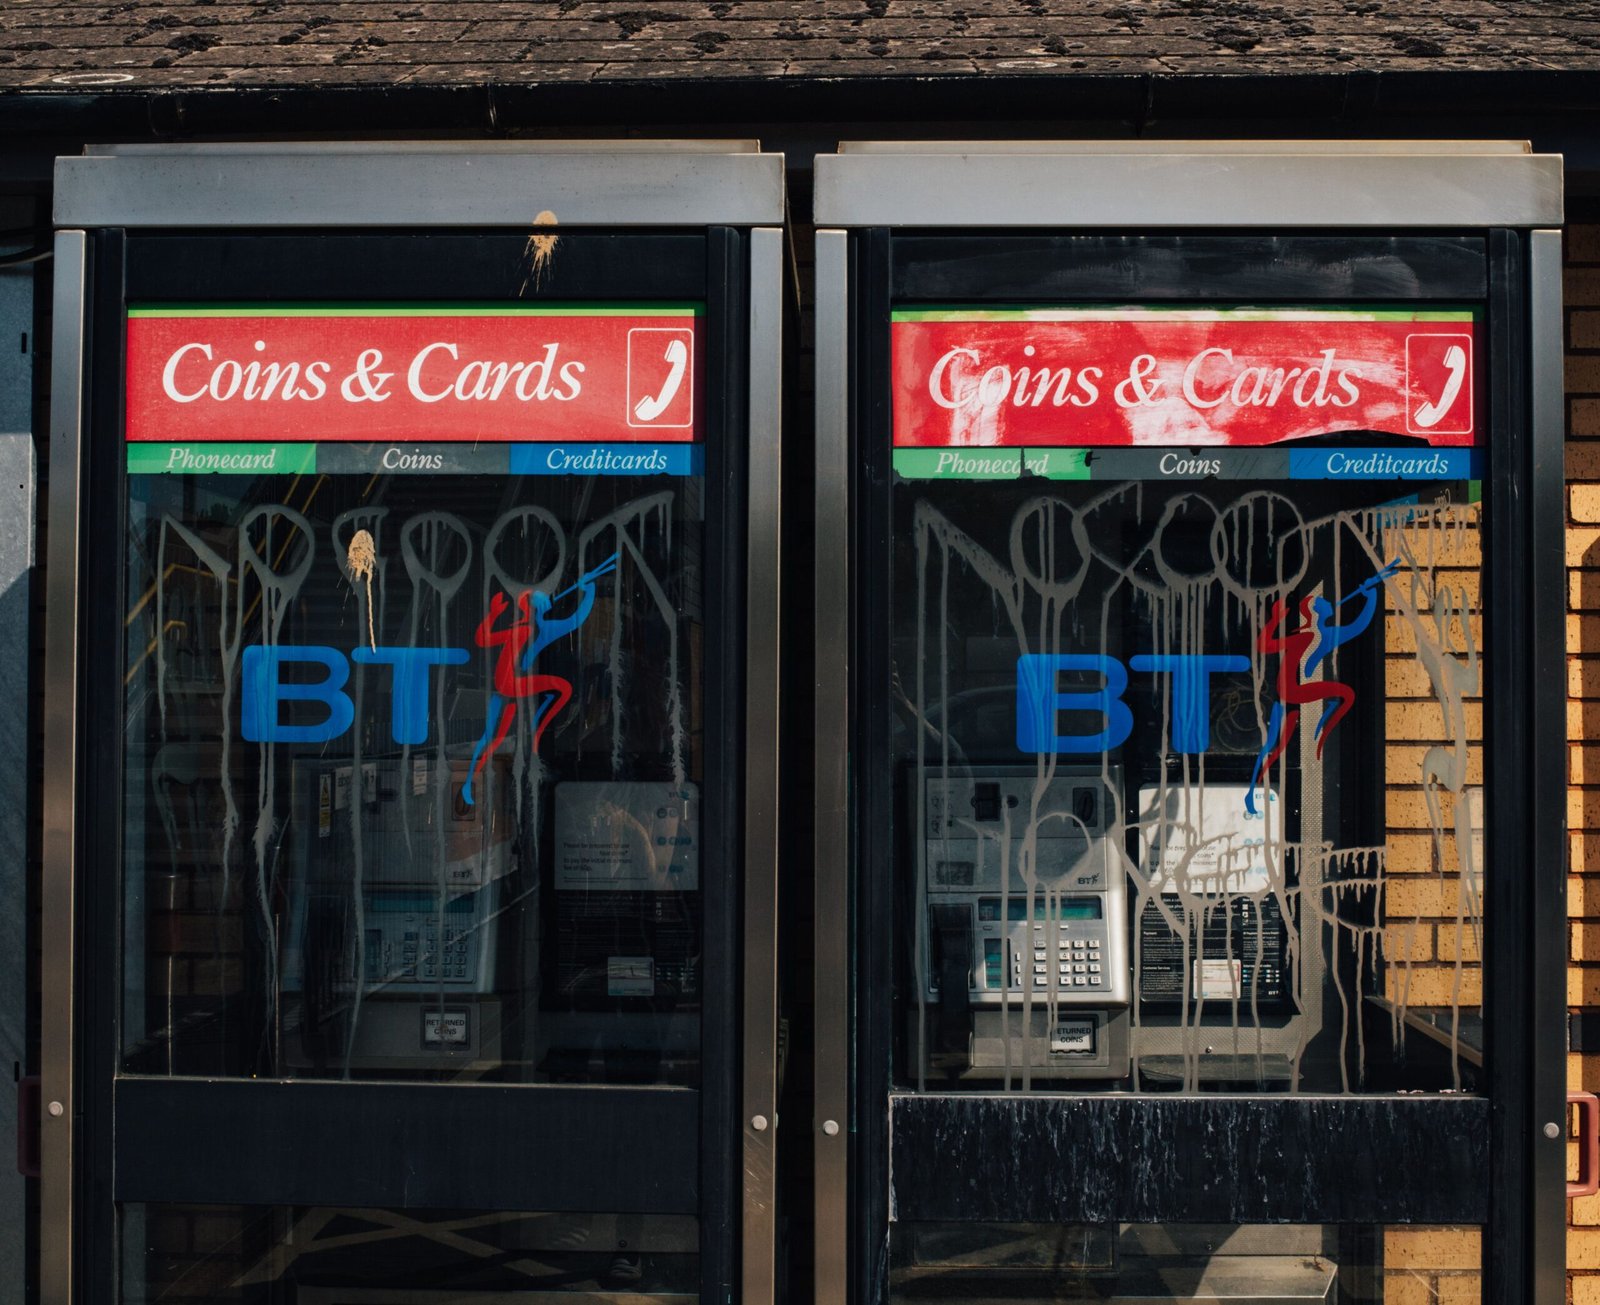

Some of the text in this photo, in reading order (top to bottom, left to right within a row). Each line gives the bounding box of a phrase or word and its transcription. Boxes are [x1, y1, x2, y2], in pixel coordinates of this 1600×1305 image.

[162, 340, 586, 403] Coins & Cards
[928, 345, 1363, 410] Coins & Cards
[166, 448, 276, 470] Phonecard
[382, 448, 443, 470] Coins
[546, 449, 668, 471] Creditcards
[1159, 453, 1221, 475] Coins
[1326, 453, 1449, 475] Creditcards
[241, 644, 470, 745] BT
[1016, 653, 1251, 754] BT
[1055, 1027, 1092, 1035] ETURNED
